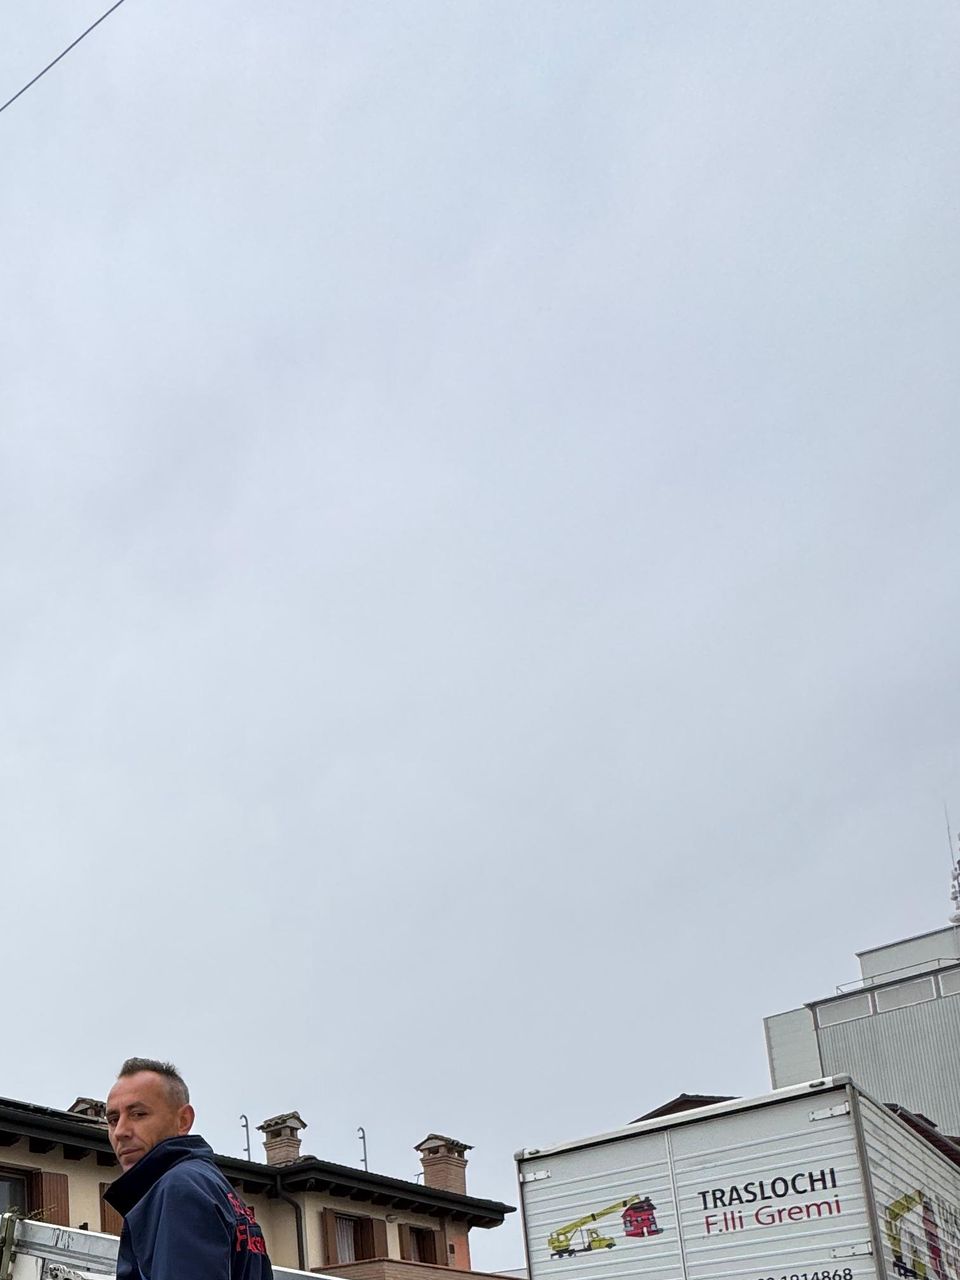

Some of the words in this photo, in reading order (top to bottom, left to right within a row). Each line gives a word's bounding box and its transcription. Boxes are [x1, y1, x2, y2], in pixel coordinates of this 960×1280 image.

[698, 1167, 837, 1210] TRASLOCHI
[704, 1210, 744, 1234] F.lli
[754, 1194, 841, 1226] Gremi
